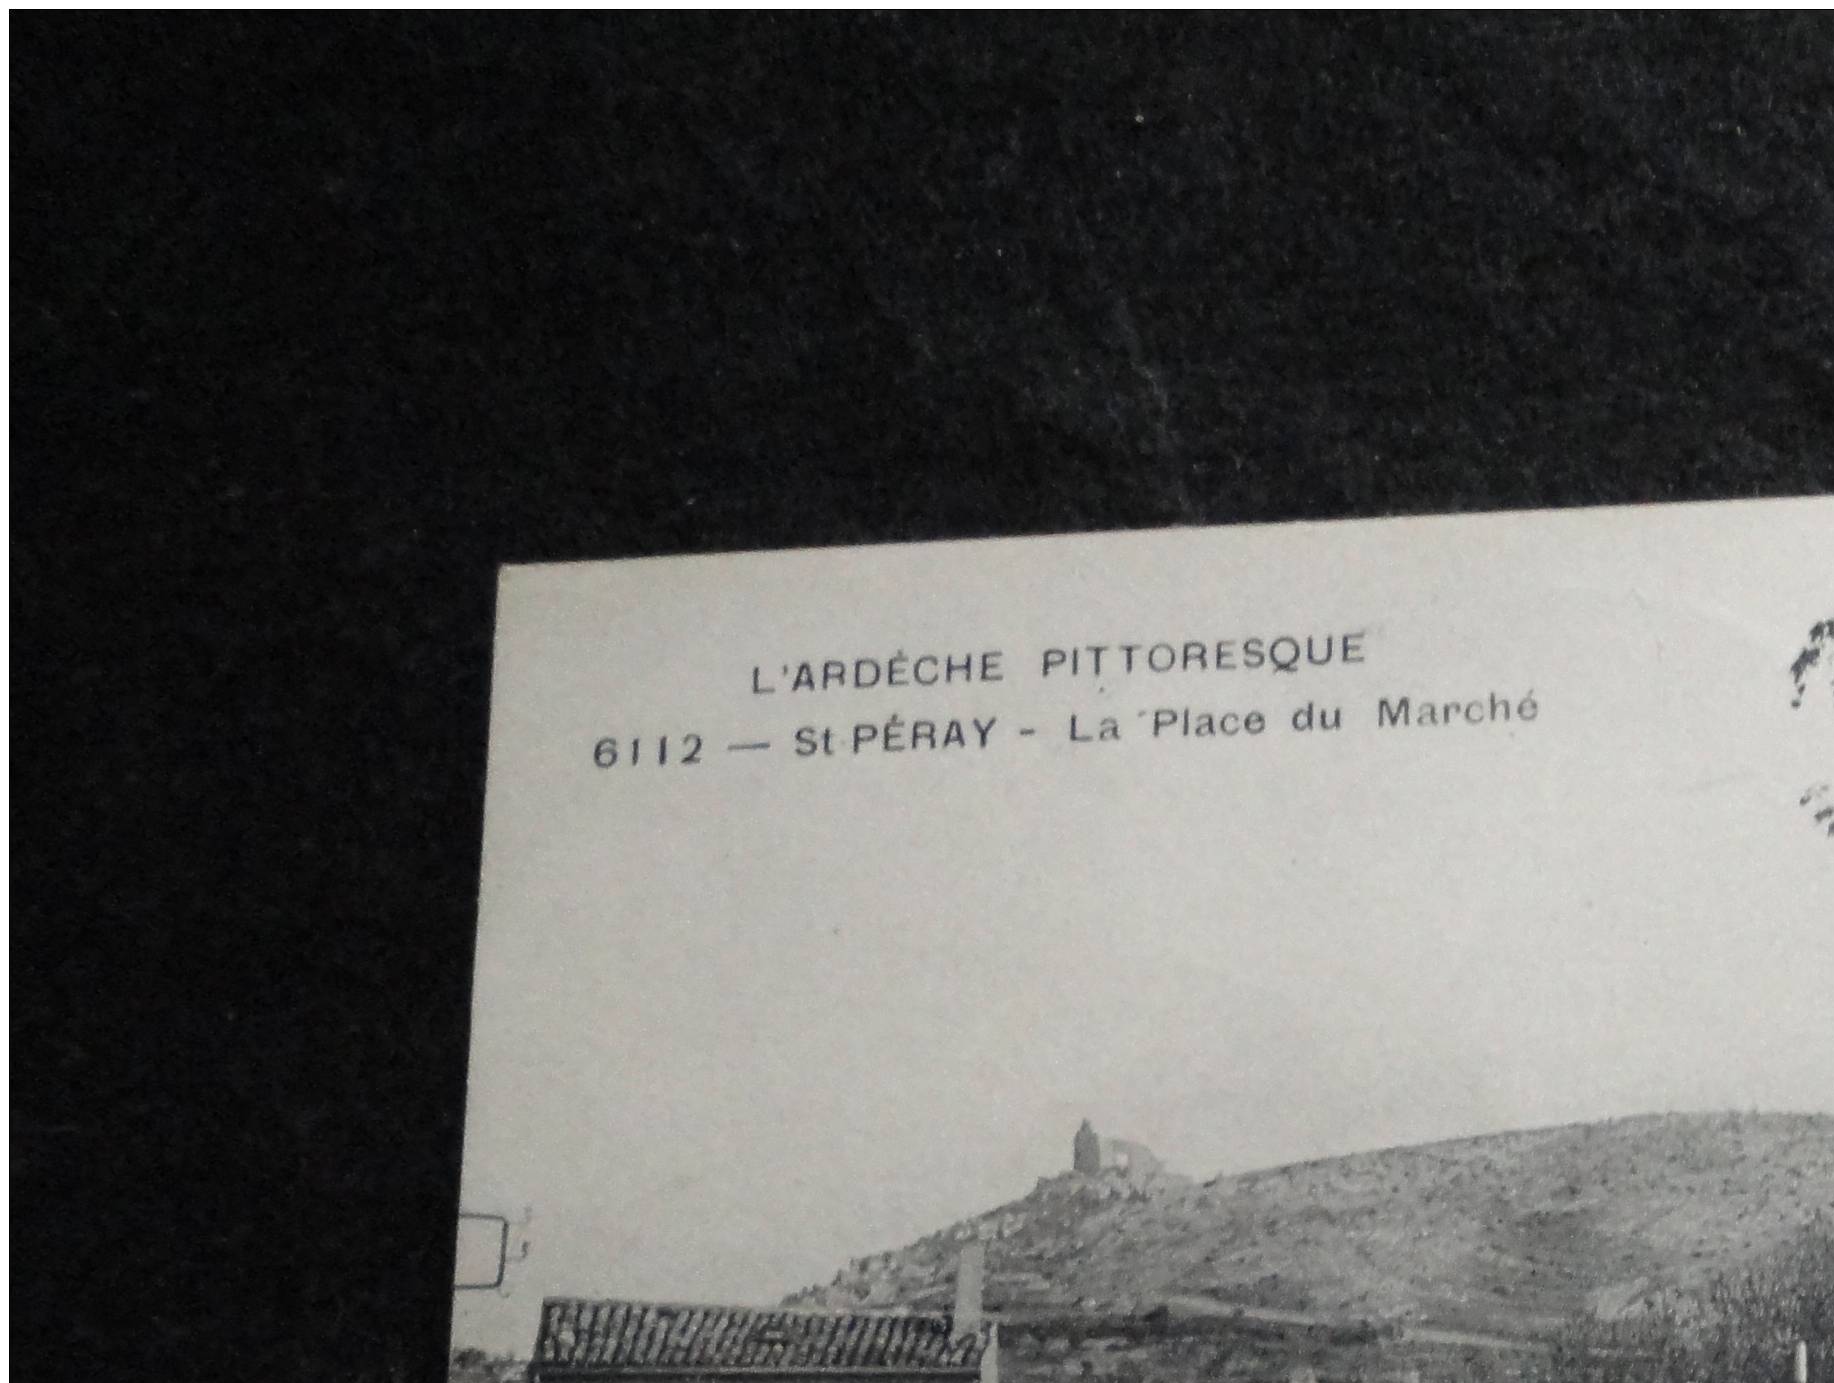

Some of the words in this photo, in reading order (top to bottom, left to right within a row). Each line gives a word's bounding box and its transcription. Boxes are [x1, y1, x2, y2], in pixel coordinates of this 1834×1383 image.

[1042, 632, 1366, 677] PITTORESQUE
[593, 733, 703, 769] 6112
[794, 726, 834, 756] St
[853, 713, 997, 754] PÉRAY
[1069, 713, 1121, 742] La
[1152, 706, 1266, 738] Place
[1291, 701, 1342, 732] du
[1377, 688, 1539, 728] Marché
